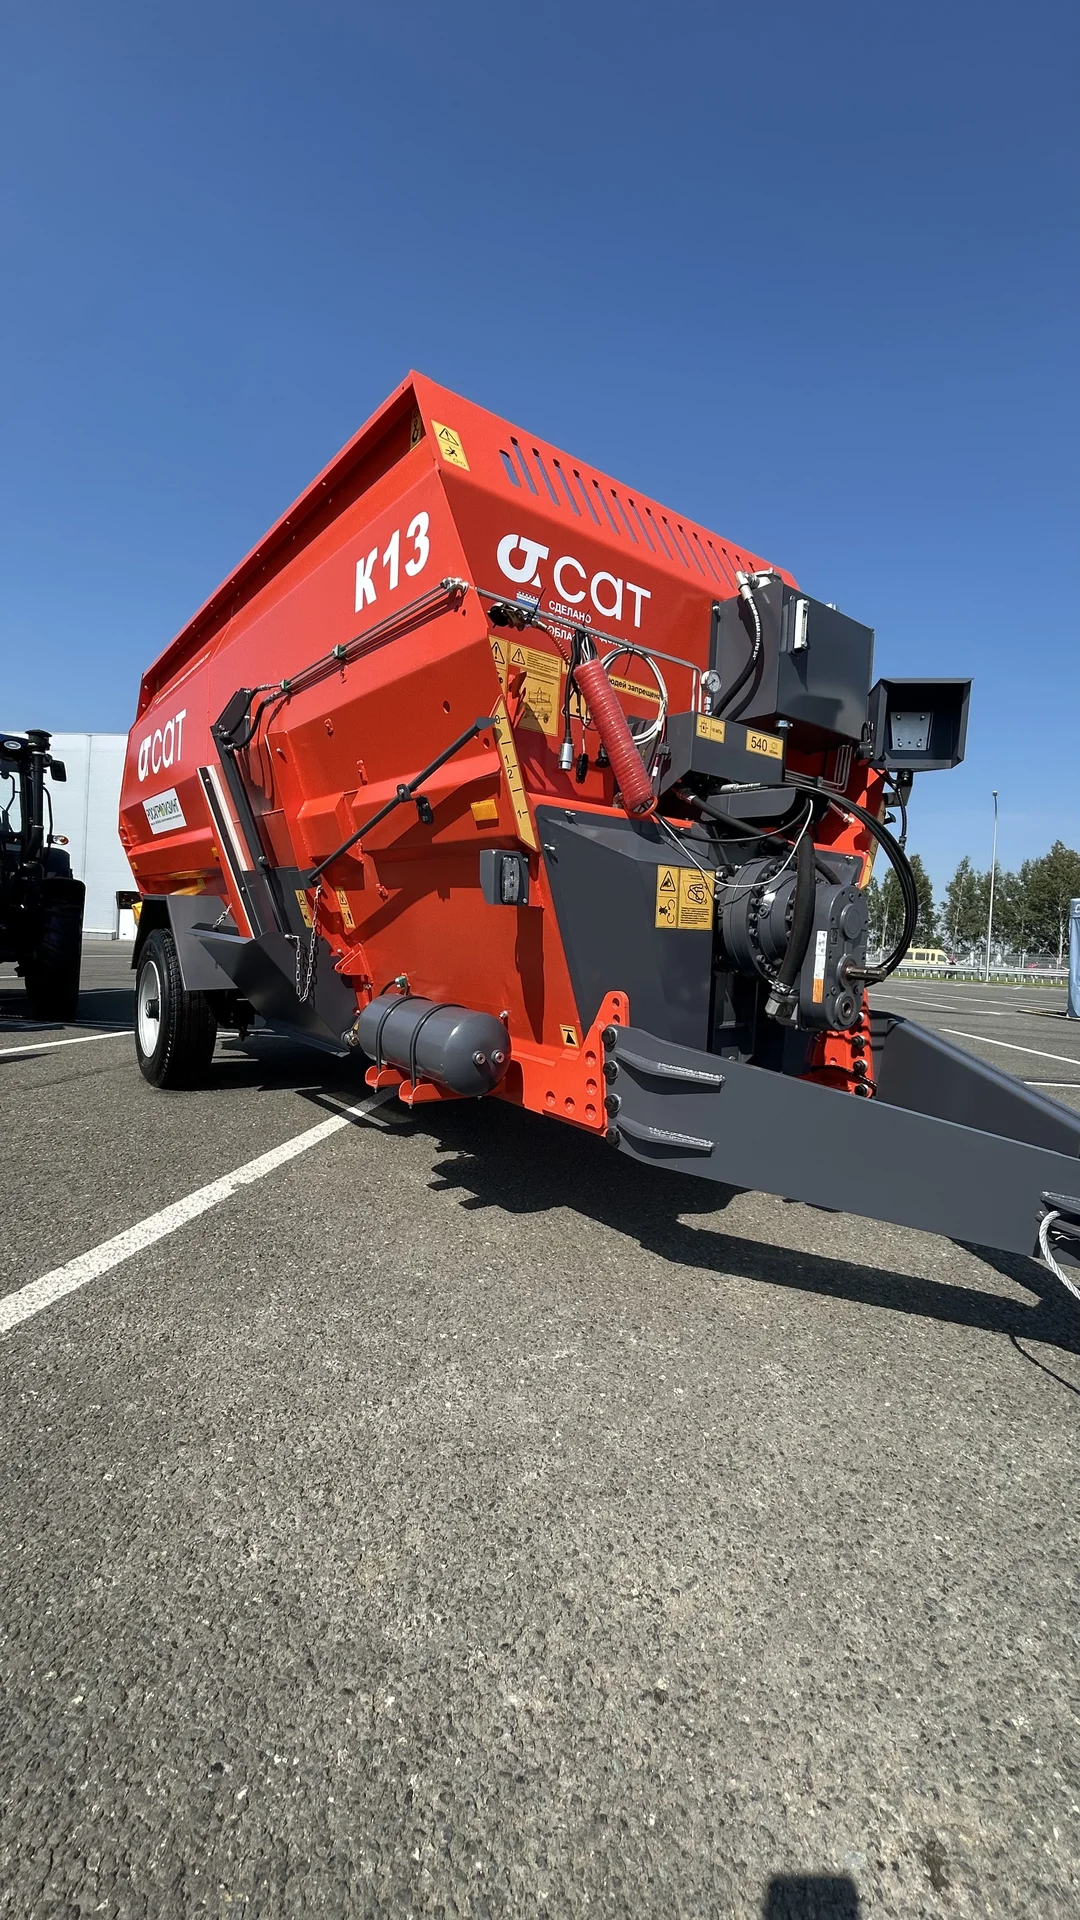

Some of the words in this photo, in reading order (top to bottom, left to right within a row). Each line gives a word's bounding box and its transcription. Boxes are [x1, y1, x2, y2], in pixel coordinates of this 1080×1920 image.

[355, 511, 430, 613] К13
[548, 600, 592, 624] СДЕЛАНО
[547, 625, 575, 641] ОБЛА
[608, 678, 627, 689] юдей
[750, 735, 768, 752] 540
